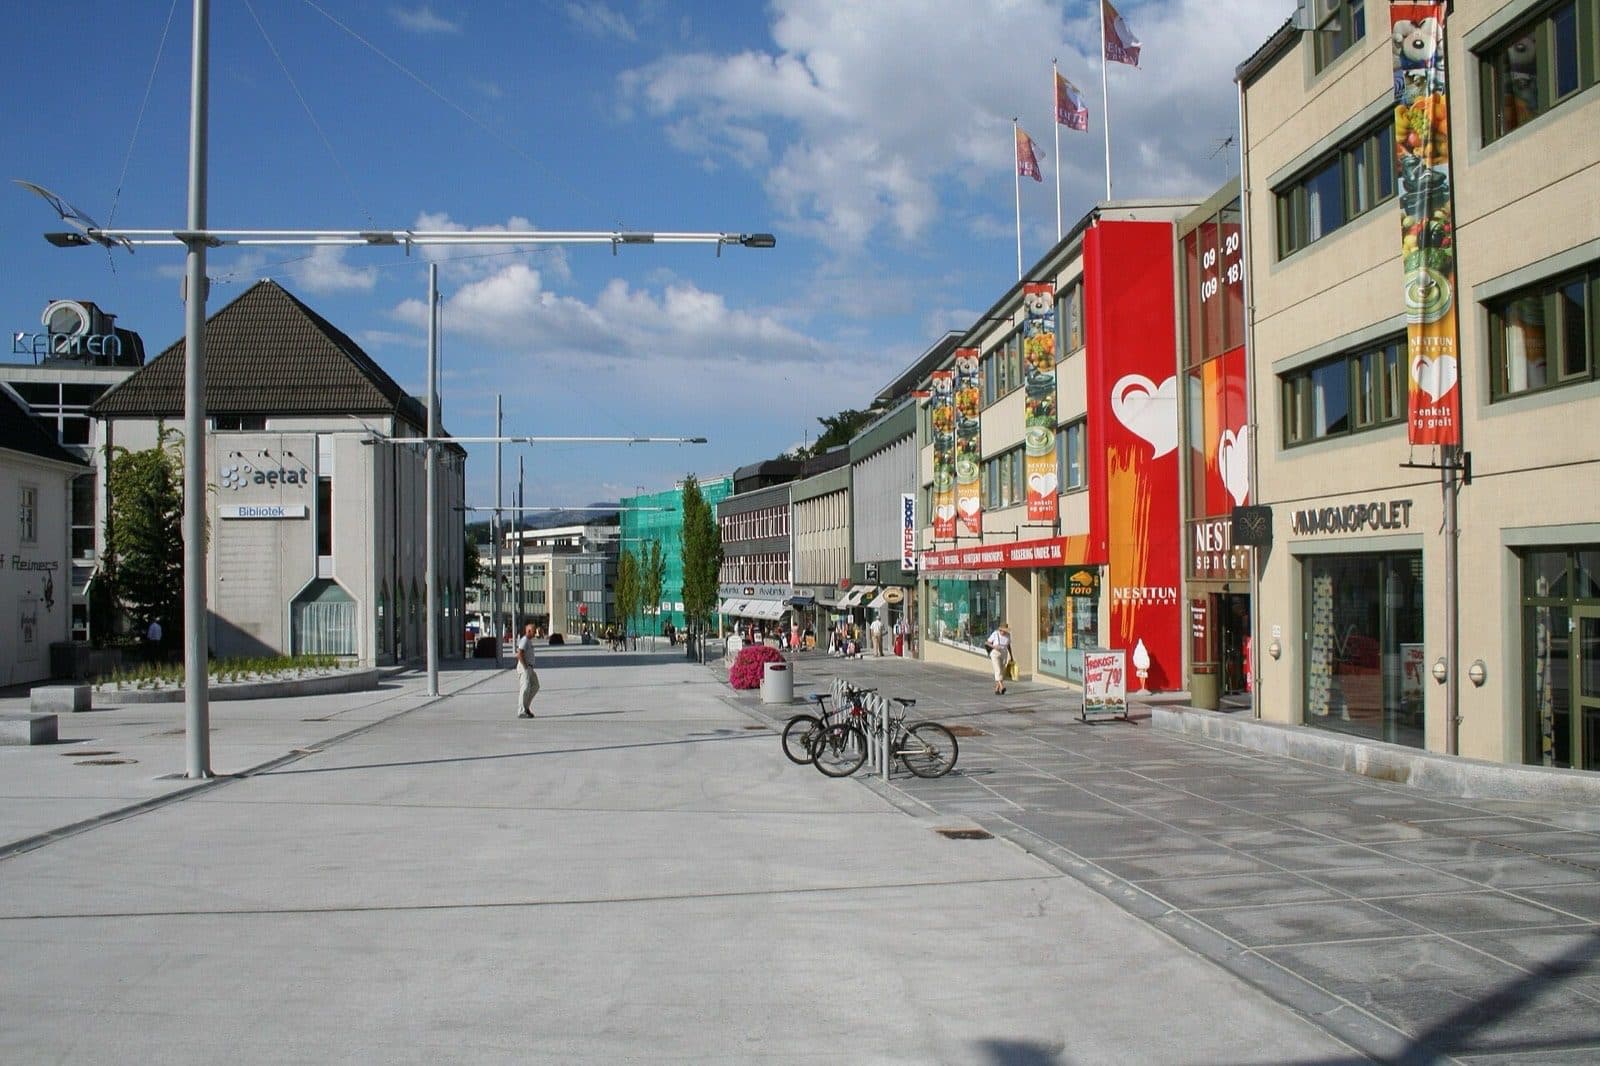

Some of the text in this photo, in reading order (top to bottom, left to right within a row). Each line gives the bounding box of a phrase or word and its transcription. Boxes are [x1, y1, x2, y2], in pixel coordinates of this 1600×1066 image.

[1204, 248, 1216, 270] 09
[1226, 232, 1239, 256] 20
[1201, 277, 1218, 303] (09
[1228, 258, 1243, 285] 18)
[253, 467, 308, 485] aetat
[239, 506, 285, 518] Bibliotek
[904, 496, 914, 558] INTERSPORT
[12, 555, 59, 571] Reimers
[1071, 587, 1092, 595] TOTO
[1113, 587, 1177, 599] NESTTUN
